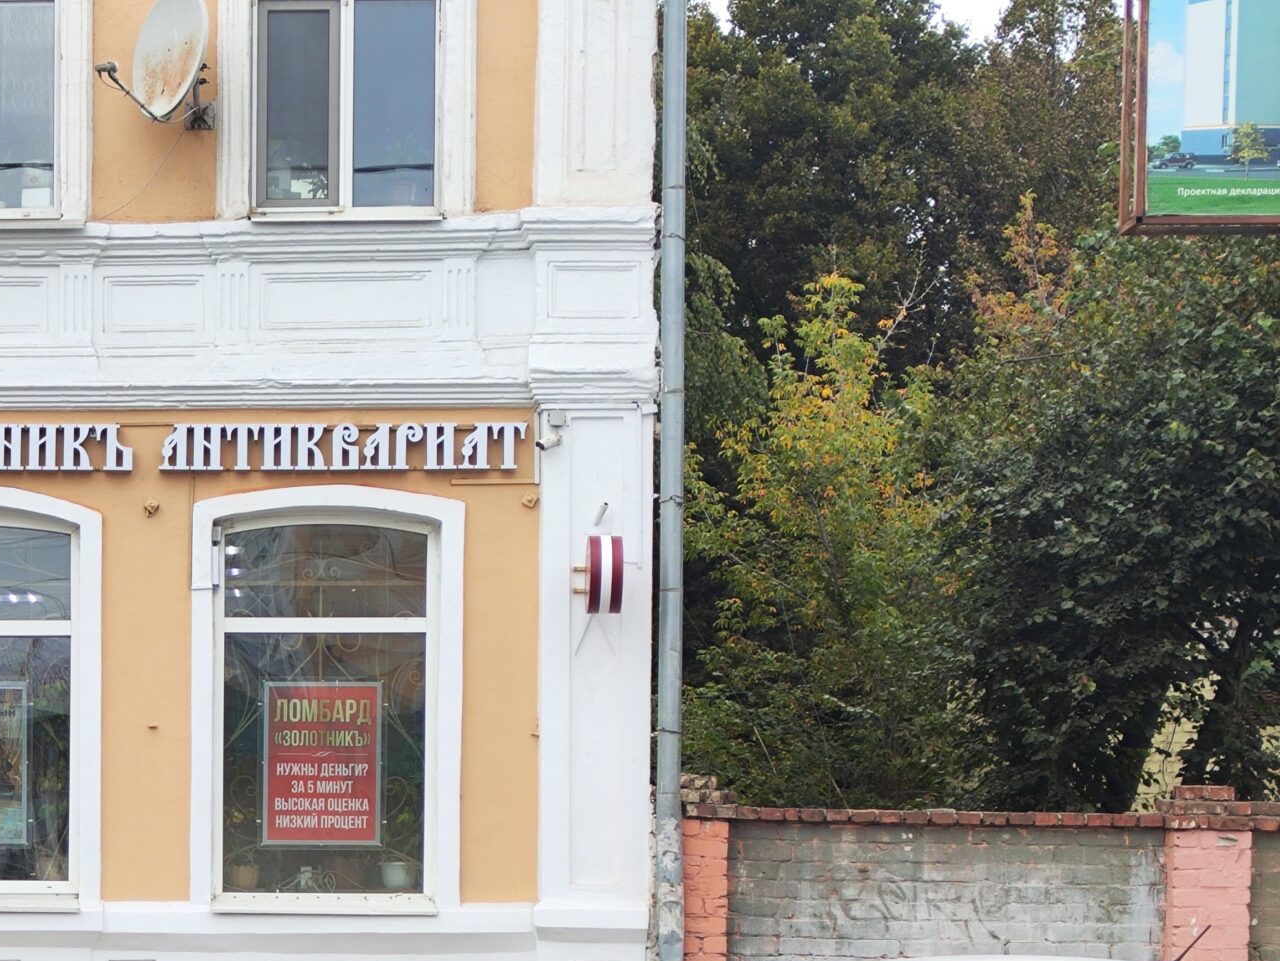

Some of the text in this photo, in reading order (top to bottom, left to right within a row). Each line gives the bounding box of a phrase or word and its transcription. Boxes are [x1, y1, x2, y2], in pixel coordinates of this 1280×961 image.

[1177, 186, 1227, 198] Проектная
[158, 421, 529, 471] АНТИКВАРИАТ
[274, 698, 372, 725] ЛОМБАРД
[274, 729, 371, 748] «ЗОЛОТНИКЪ»
[276, 762, 369, 778] НУЖНЫ ДЕНЬГИ?
[291, 780, 354, 794] ЗА 5 МИНУТ
[274, 797, 370, 813] ВЫСОКАЯ ОЦЕНКА
[275, 812, 369, 830] НИЗКИЙ ПРОЦЕНТ
